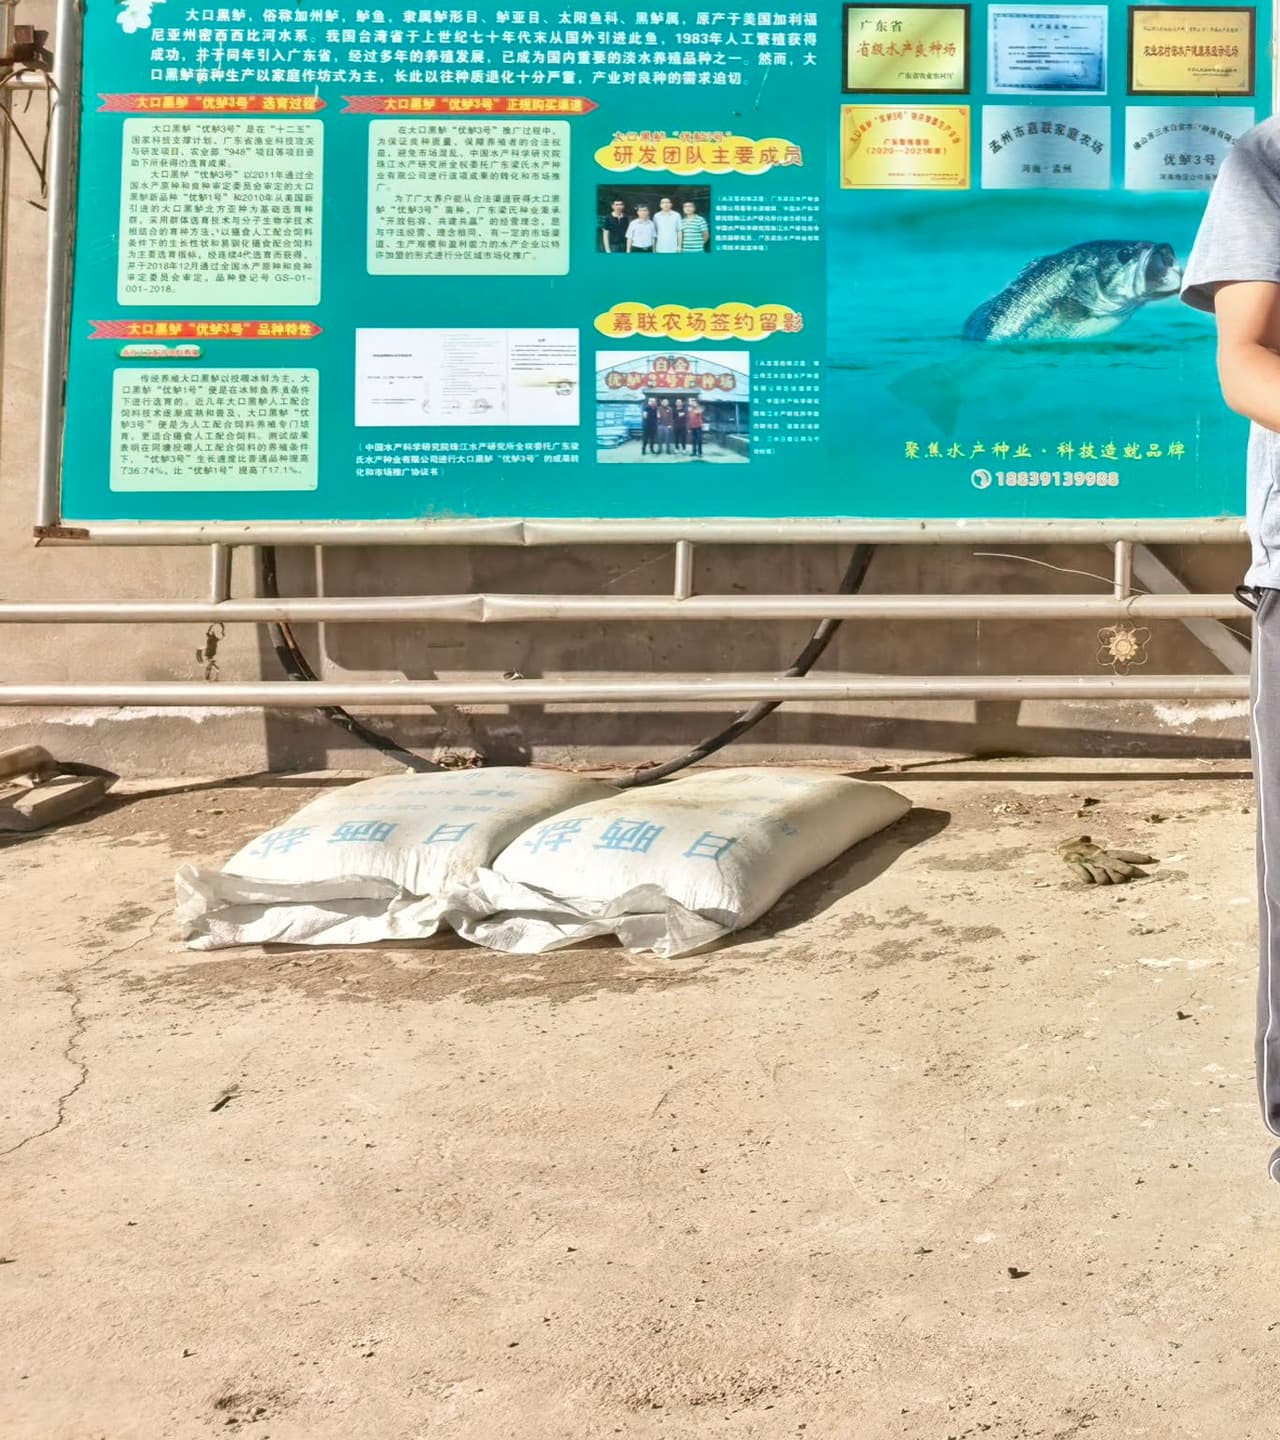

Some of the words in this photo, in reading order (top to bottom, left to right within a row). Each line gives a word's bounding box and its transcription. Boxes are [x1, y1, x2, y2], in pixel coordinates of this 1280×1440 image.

[858, 19, 904, 33] 广东省
[613, 144, 803, 166] 研发团队主要成员
[613, 312, 804, 333] 嘉联农场签约留影
